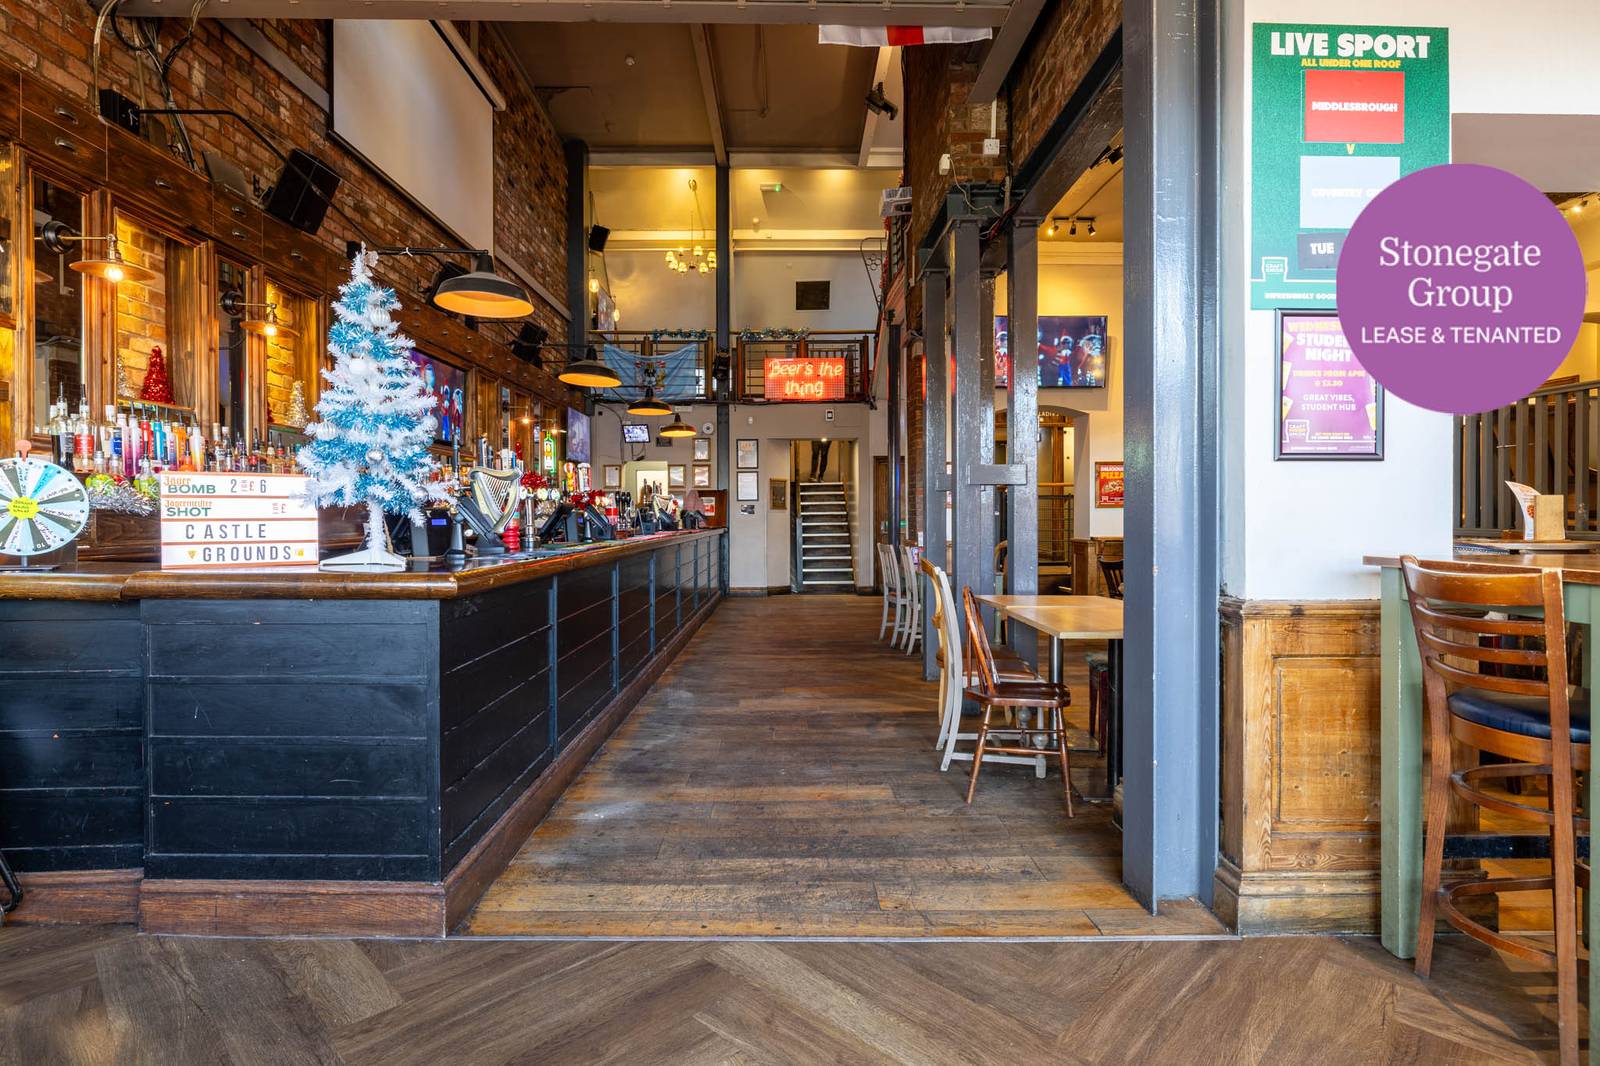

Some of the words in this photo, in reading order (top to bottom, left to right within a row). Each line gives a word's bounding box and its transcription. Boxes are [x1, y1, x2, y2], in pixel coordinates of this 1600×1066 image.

[1270, 31, 1329, 56] LIVE
[1337, 32, 1431, 59] SPORT
[1301, 58, 1318, 67] ALL
[1319, 58, 1351, 68] UNDER
[1352, 59, 1373, 68] ONE
[1373, 59, 1401, 69] ROOF
[1311, 101, 1399, 112] MIDDLESBROUGH
[1309, 242, 1336, 255] TUE
[1304, 347, 1352, 362] NIGHT
[768, 360, 814, 378] Beer's
[818, 361, 843, 377] the
[784, 380, 824, 397] thing
[1303, 393, 1328, 401] GREAT
[1301, 403, 1339, 411] STUDENT
[1340, 403, 1357, 411] HUB
[167, 484, 216, 494] BOMB
[230, 478, 237, 494] 2
[260, 479, 267, 494] 6
[166, 507, 212, 517] SHOT
[185, 523, 267, 540] CASTLE
[202, 545, 292, 563] GROUNDS
